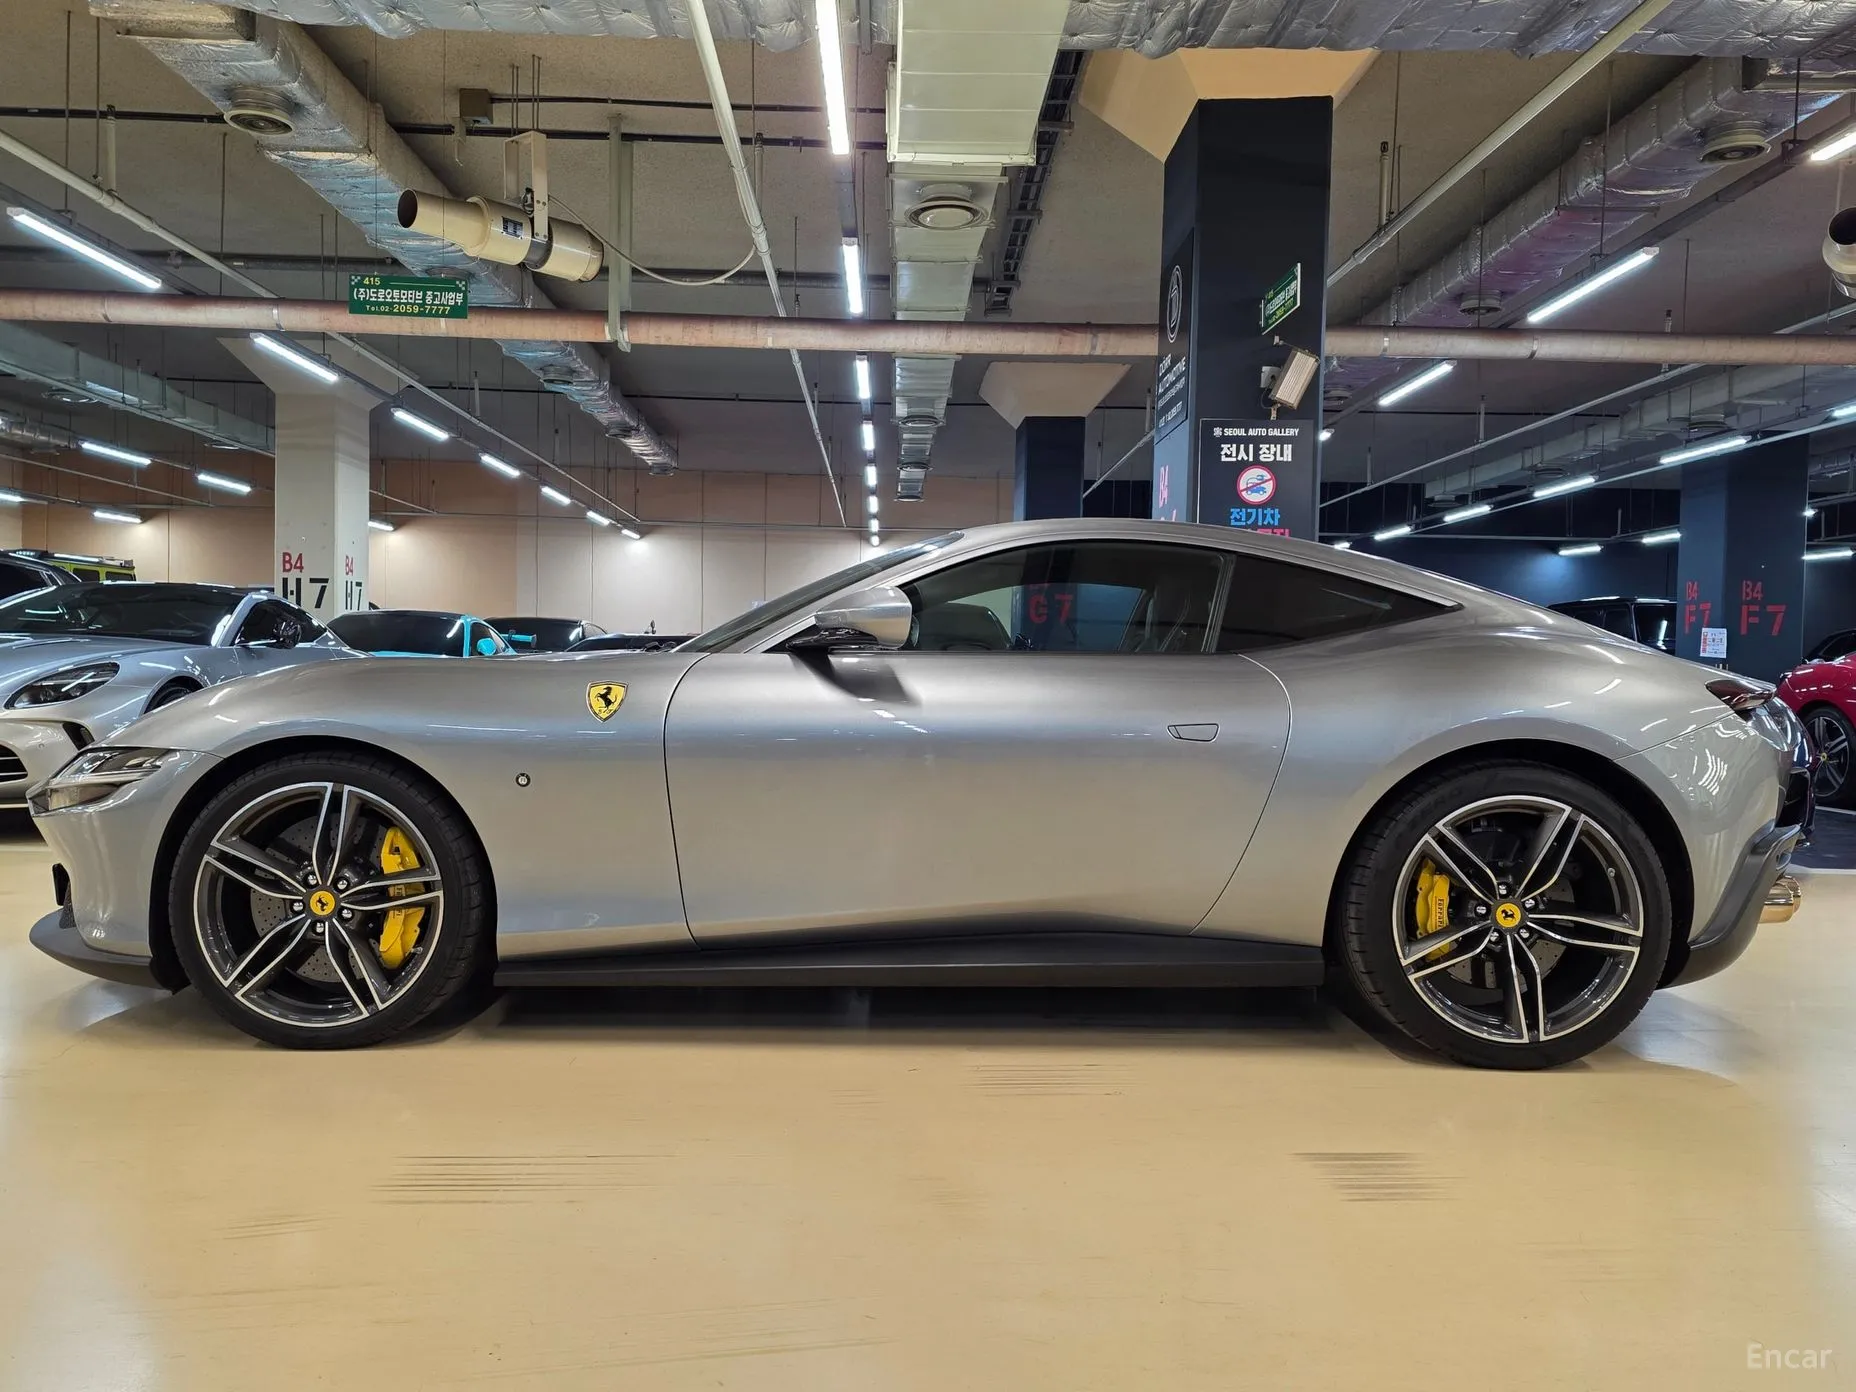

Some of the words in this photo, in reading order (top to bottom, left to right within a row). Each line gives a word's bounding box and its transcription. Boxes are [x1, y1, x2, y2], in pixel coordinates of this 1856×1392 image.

[363, 277, 381, 286] 415
[425, 291, 464, 306] 중고사업부
[1223, 428, 1247, 436] SEOUL
[1248, 428, 1266, 436] AUTO
[1268, 428, 1299, 437] GALLERY
[1220, 443, 1254, 462] 전시
[1259, 443, 1292, 462] 장내
[1159, 465, 1169, 508] B4
[1230, 507, 1280, 526] 전기차
[282, 552, 304, 573] B4
[345, 555, 354, 576] B4
[282, 577, 329, 609] H7
[345, 580, 362, 611] H7
[1686, 581, 1698, 600] B4
[1743, 580, 1763, 601] B4
[1685, 602, 1711, 635] F7
[1740, 605, 1786, 636] F7
